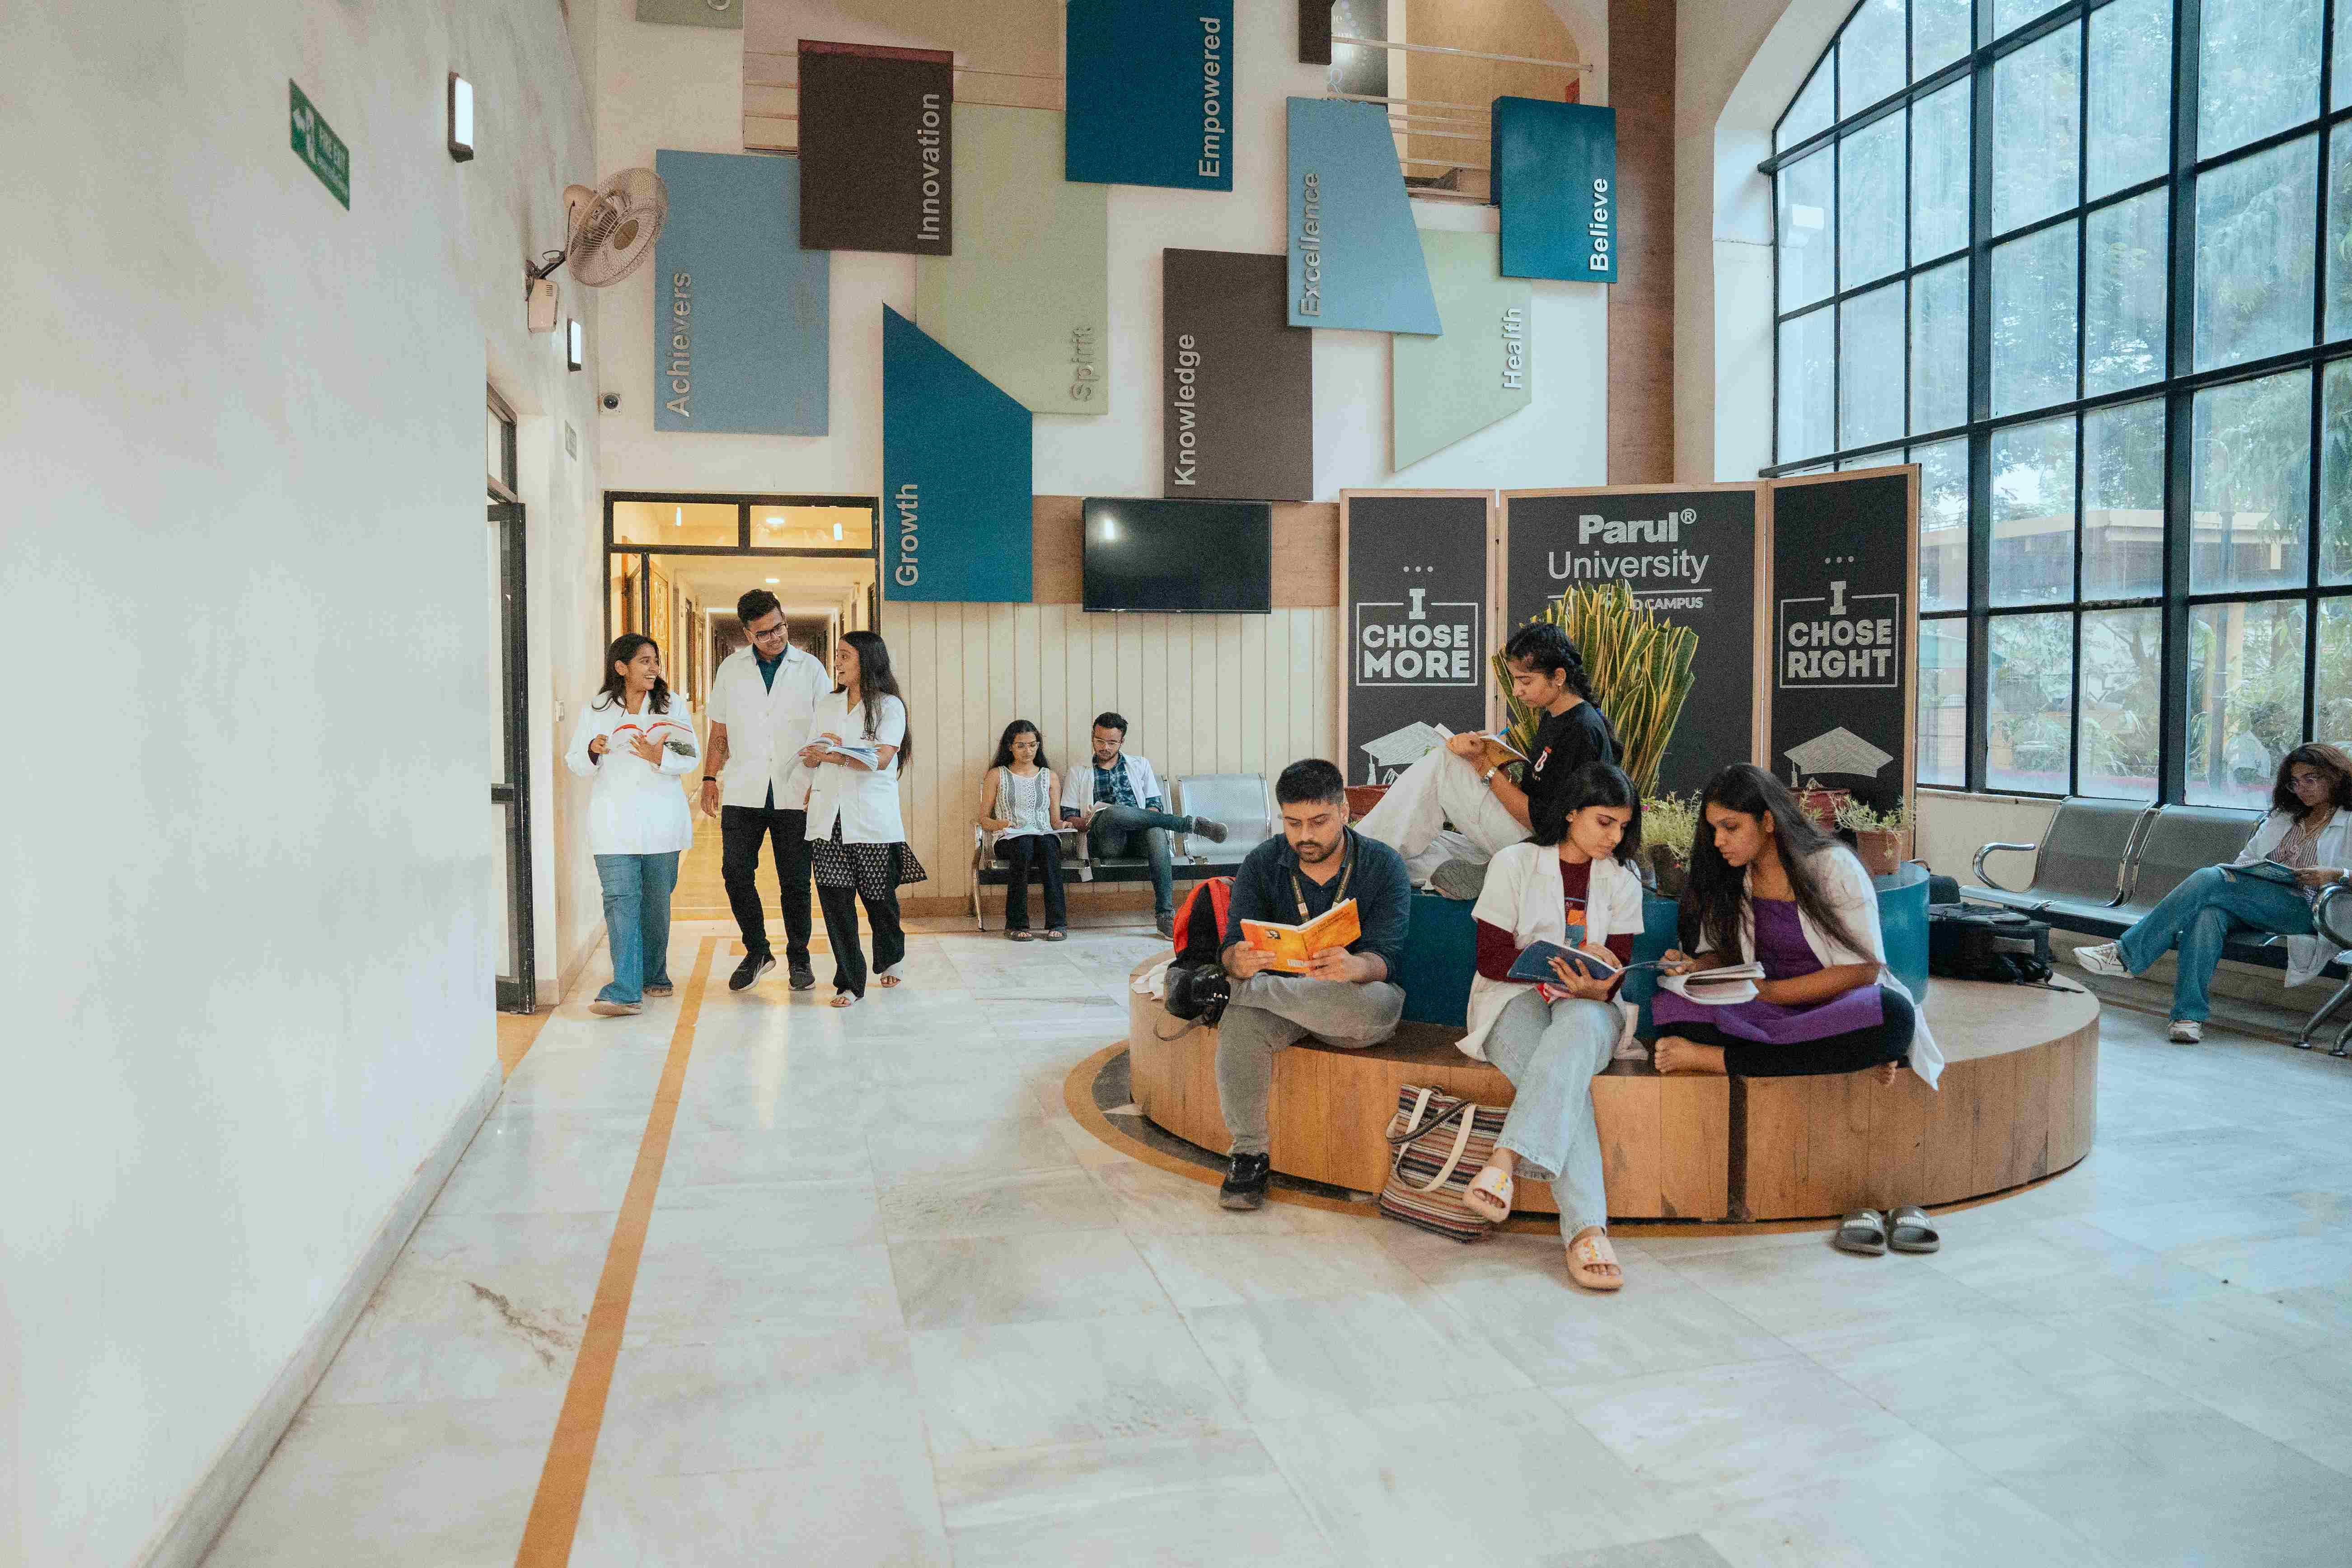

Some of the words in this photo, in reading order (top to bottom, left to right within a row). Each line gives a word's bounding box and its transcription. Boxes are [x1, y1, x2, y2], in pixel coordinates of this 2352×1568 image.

[1199, 17, 1225, 177] Empowered
[917, 94, 940, 240] Innovation
[1299, 173, 1321, 316] Excellence
[1589, 178, 1609, 271] Believe
[665, 272, 691, 417] Achievers
[1070, 326, 1100, 402] Spirit
[1503, 307, 1522, 389] Health
[1174, 334, 1201, 486] Knowledge
[895, 484, 918, 587] Growth
[1548, 549, 1710, 584] University
[1362, 624, 1469, 648] CHOSE
[1409, 588, 1426, 620] I
[1645, 597, 1703, 610] CAMPUS
[1788, 618, 1892, 647] CHOSE
[1830, 581, 1846, 615] I
[1364, 650, 1470, 679] MORE
[1788, 649, 1892, 678] RIGHT
